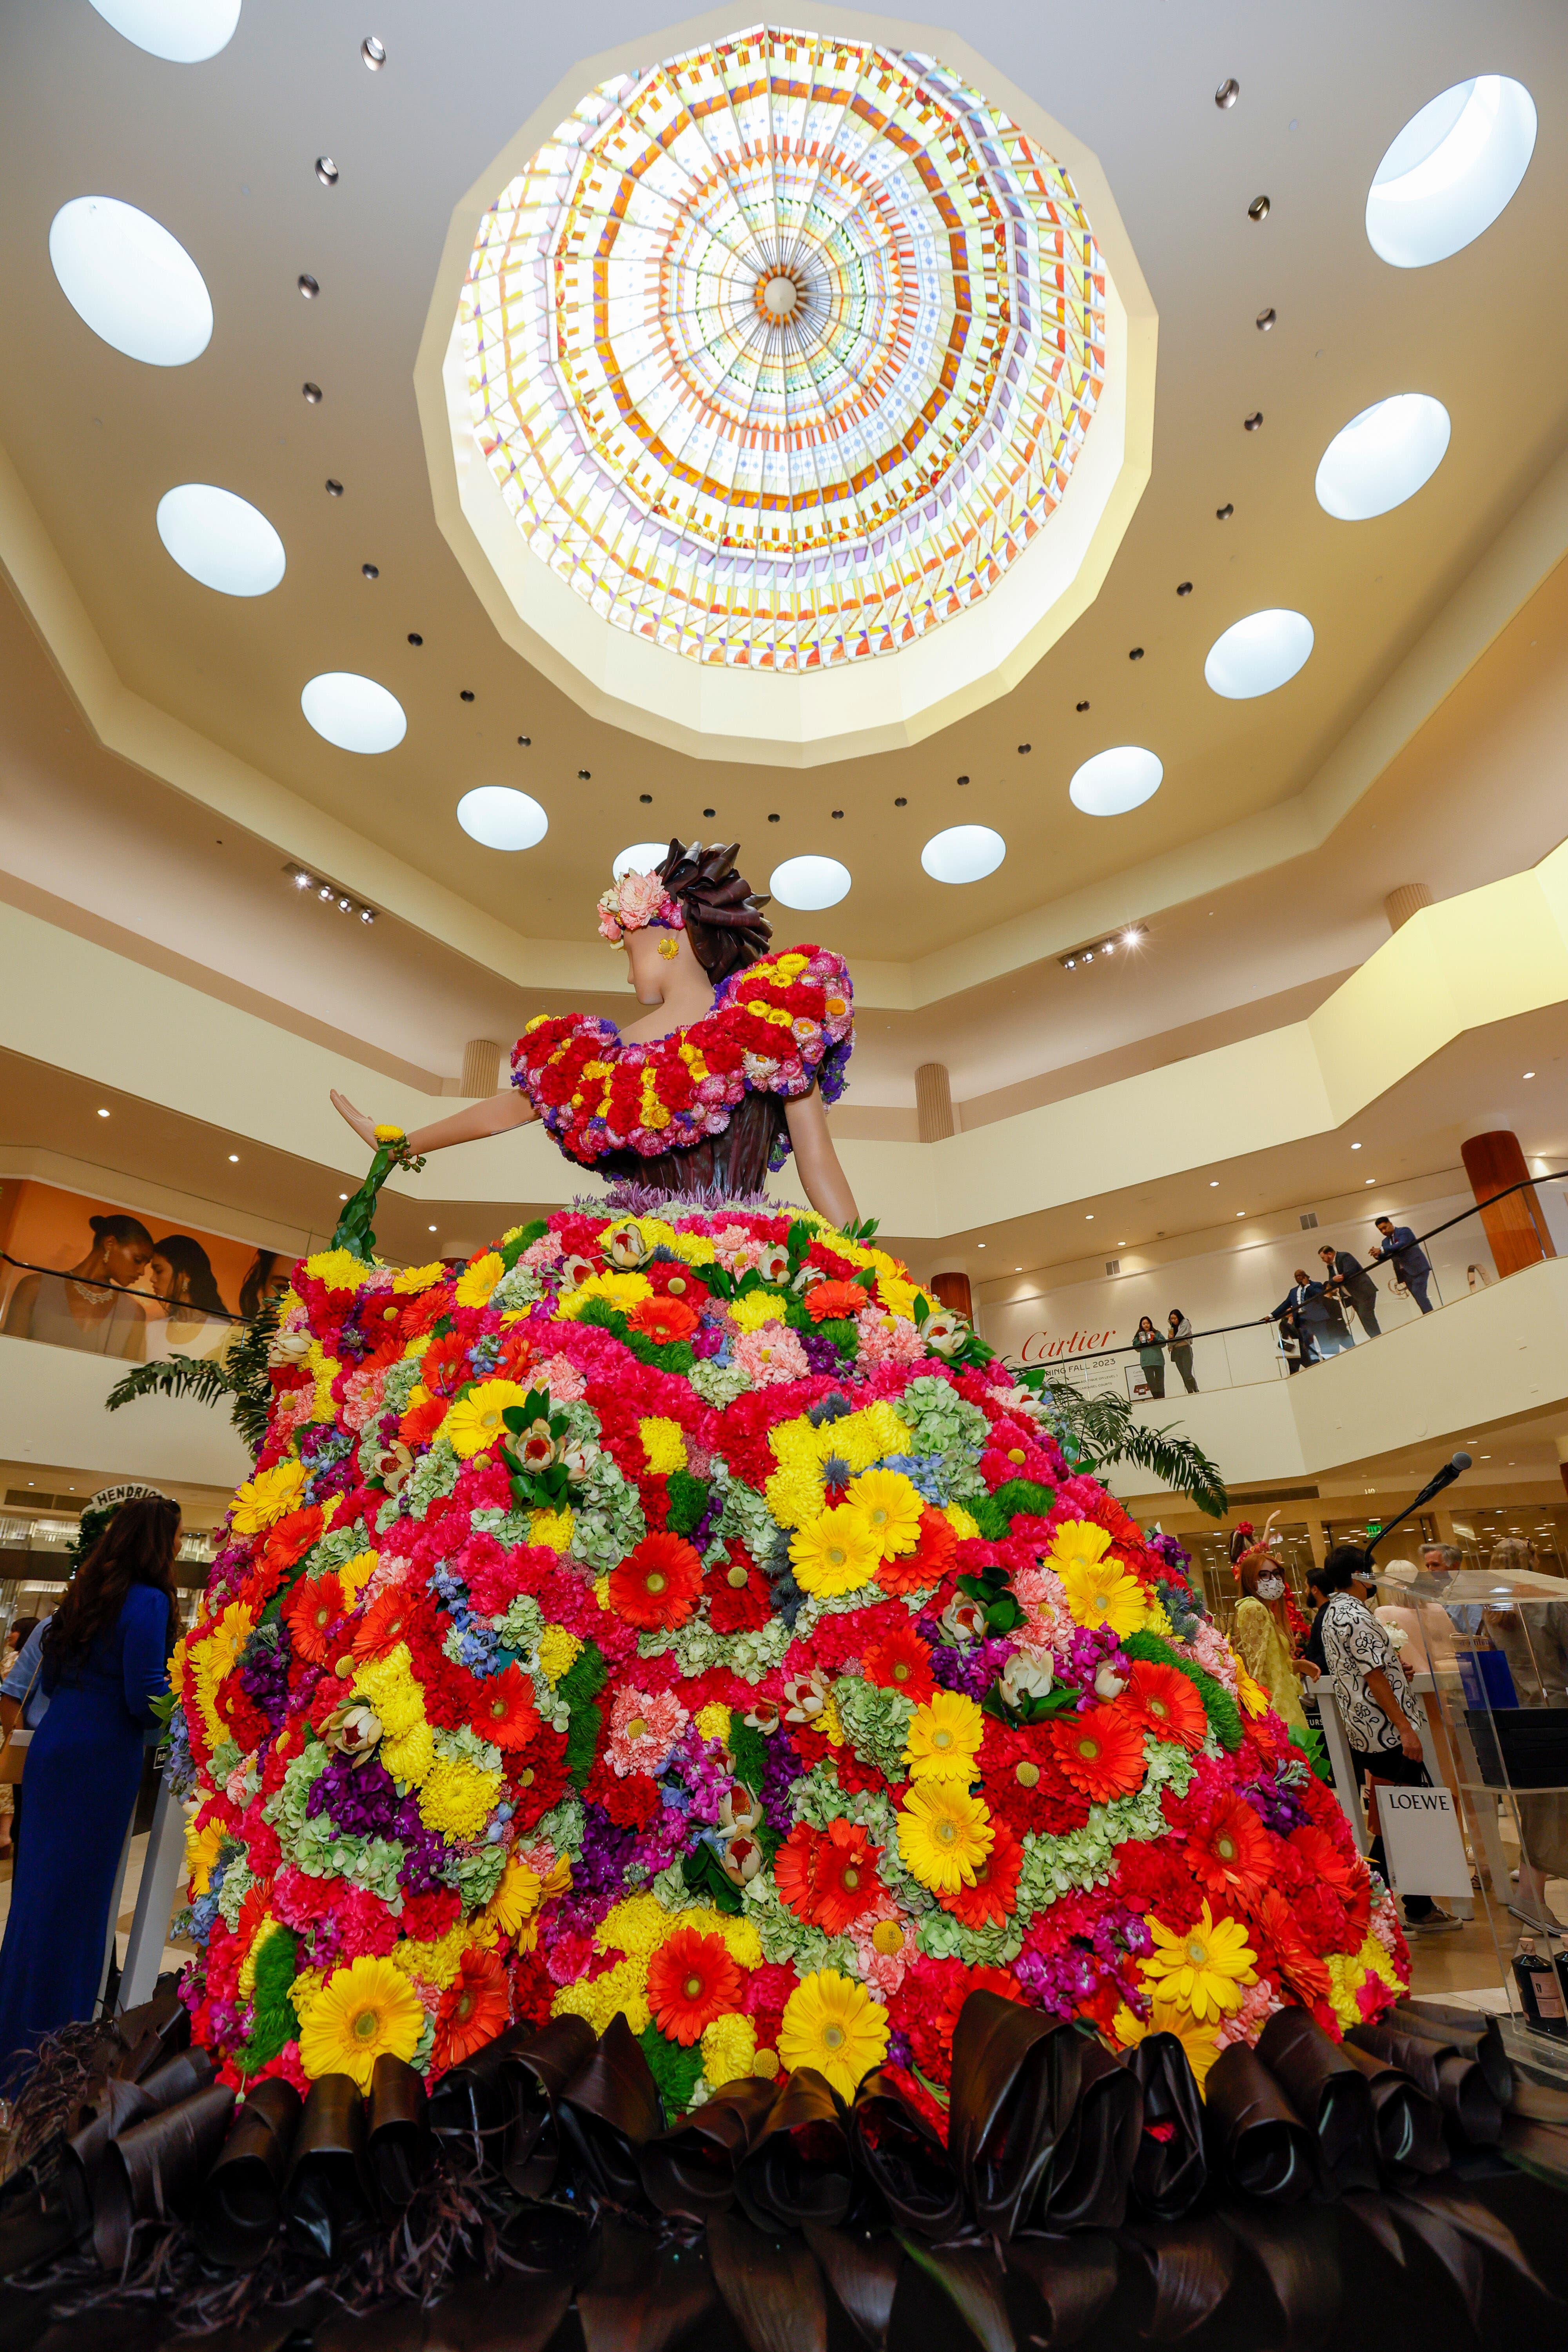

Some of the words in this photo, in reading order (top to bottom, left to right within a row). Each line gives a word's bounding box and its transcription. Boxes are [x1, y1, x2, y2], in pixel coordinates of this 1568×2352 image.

[1022, 1330, 1116, 1361] Cartier
[1093, 1358, 1116, 1368] 2023
[1389, 1794, 1450, 1810] LOEWE
